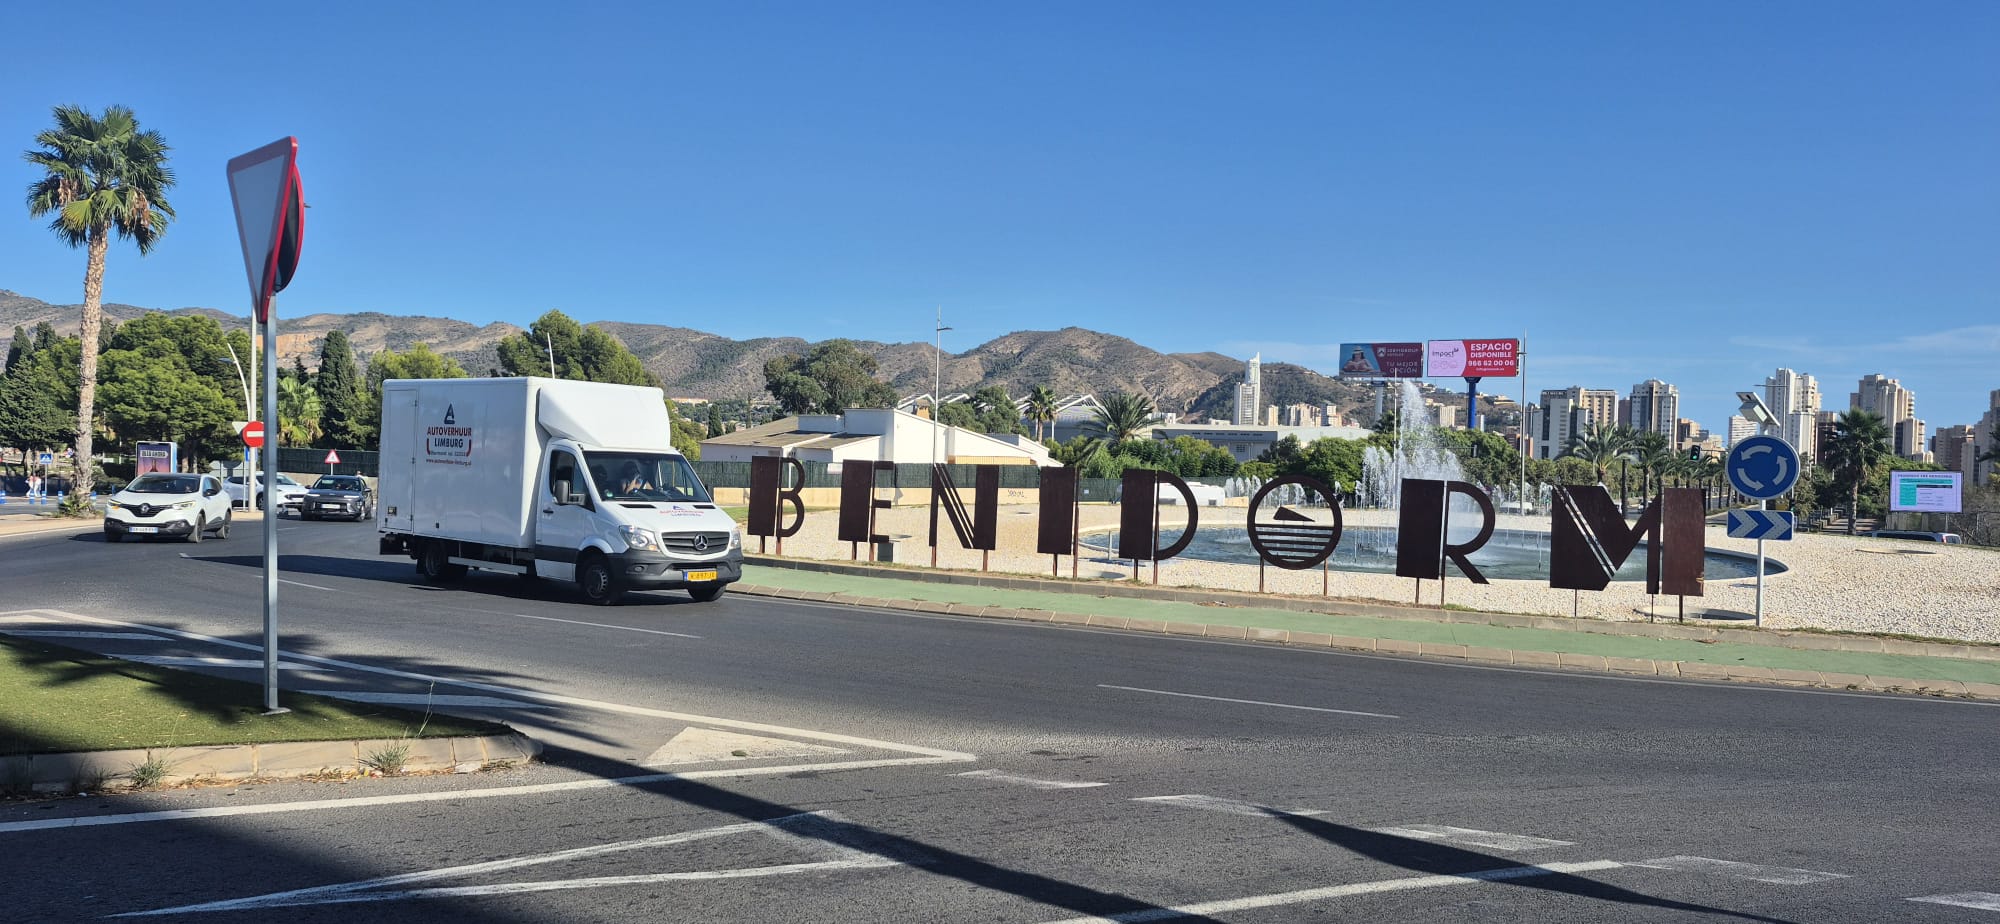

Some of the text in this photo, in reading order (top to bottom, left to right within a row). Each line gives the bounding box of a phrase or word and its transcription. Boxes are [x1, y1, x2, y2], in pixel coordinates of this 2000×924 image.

[427, 426, 472, 437] AUTOVERHUUR
[434, 438, 464, 448] LIMBURG
[748, 456, 1705, 597] BENIDORM
